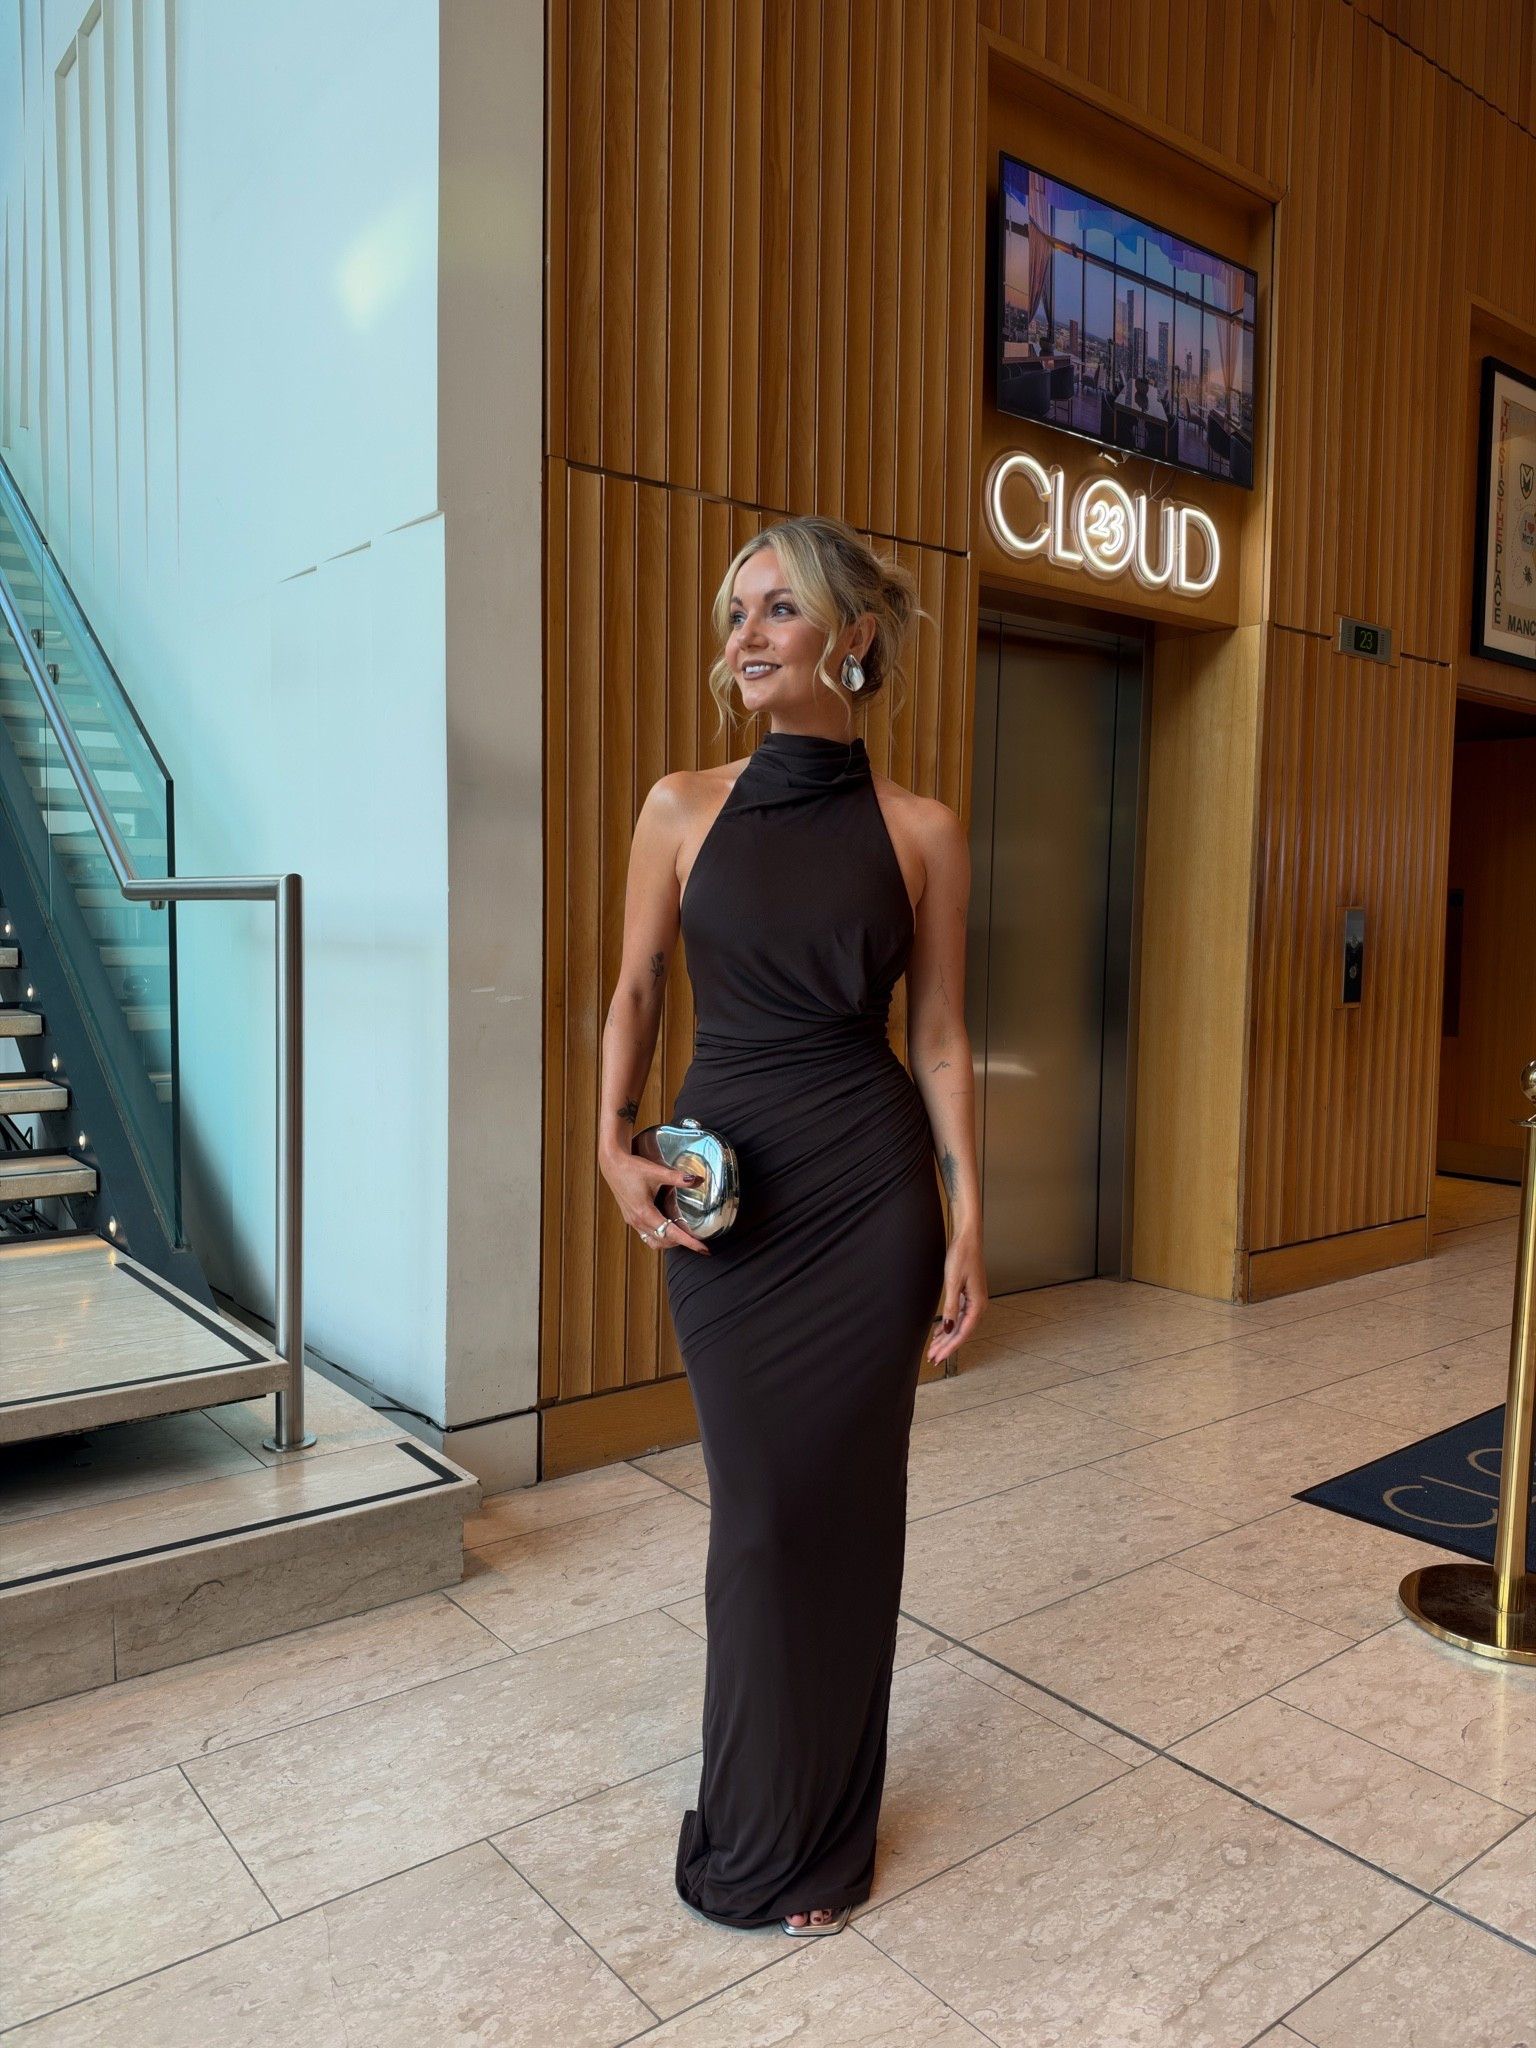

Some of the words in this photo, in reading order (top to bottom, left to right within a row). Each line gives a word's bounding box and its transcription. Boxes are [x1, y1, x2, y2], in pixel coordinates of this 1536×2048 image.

[1499, 400, 1509, 464] THIS
[1497, 465, 1504, 497] IS
[988, 453, 1221, 594] CLOUD
[1087, 500, 1126, 556] 23
[1494, 544, 1502, 624] PLACE
[1360, 630, 1373, 650] 23
